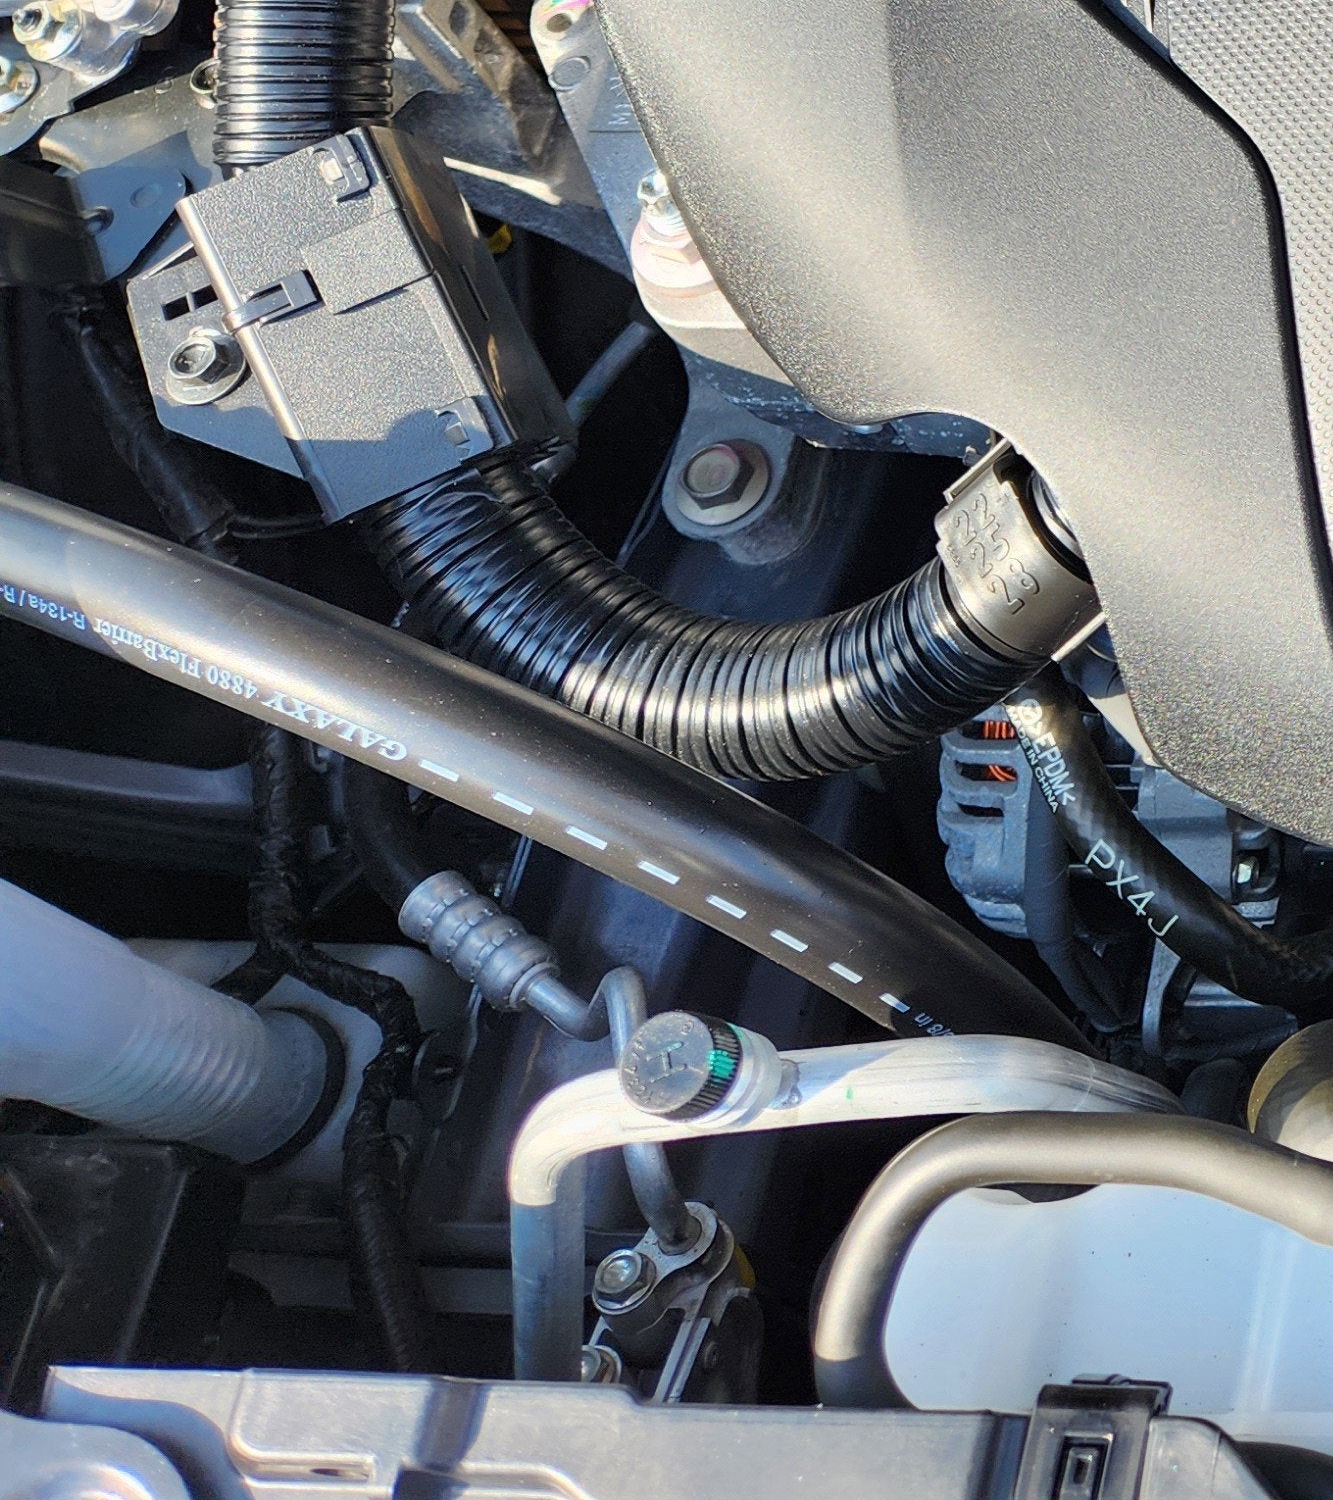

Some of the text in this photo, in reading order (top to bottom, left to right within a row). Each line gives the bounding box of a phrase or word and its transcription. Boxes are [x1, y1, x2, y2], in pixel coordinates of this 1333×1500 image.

[955, 492, 996, 546] 22
[971, 522, 1010, 579] 25
[28, 594, 86, 630] R-134a
[987, 558, 1040, 615] 28
[93, 618, 202, 679] FlexBarrier
[206, 665, 258, 699] 4880
[261, 690, 407, 761] GALAXY
[1027, 746, 1040, 766] IN
[1034, 765, 1061, 814] CHINA
[1084, 838, 1180, 937] PX4J
